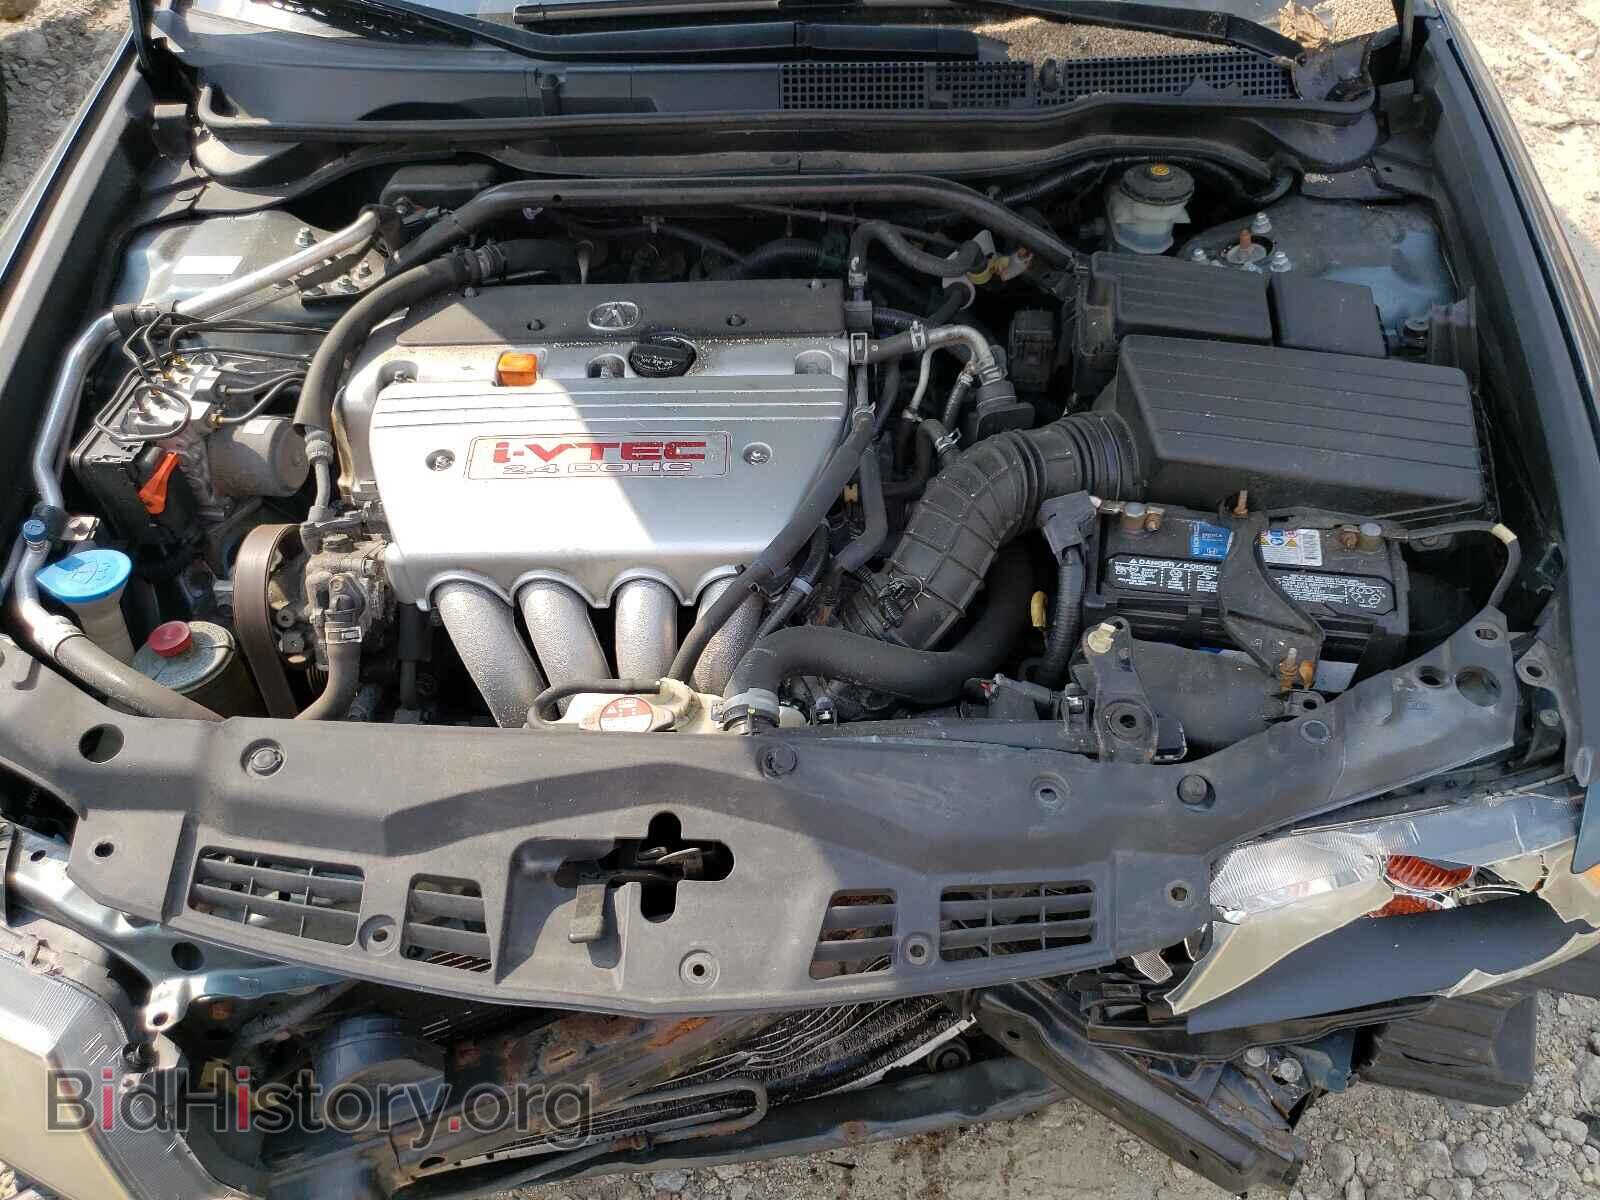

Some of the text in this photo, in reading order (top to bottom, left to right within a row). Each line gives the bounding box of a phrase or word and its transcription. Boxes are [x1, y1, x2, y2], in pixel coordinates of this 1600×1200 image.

[493, 441, 707, 463] i-VTEC
[502, 462, 694, 475] 2.4 DOHC
[1138, 559, 1175, 568] DANGER
[1183, 563, 1218, 572] POISON
